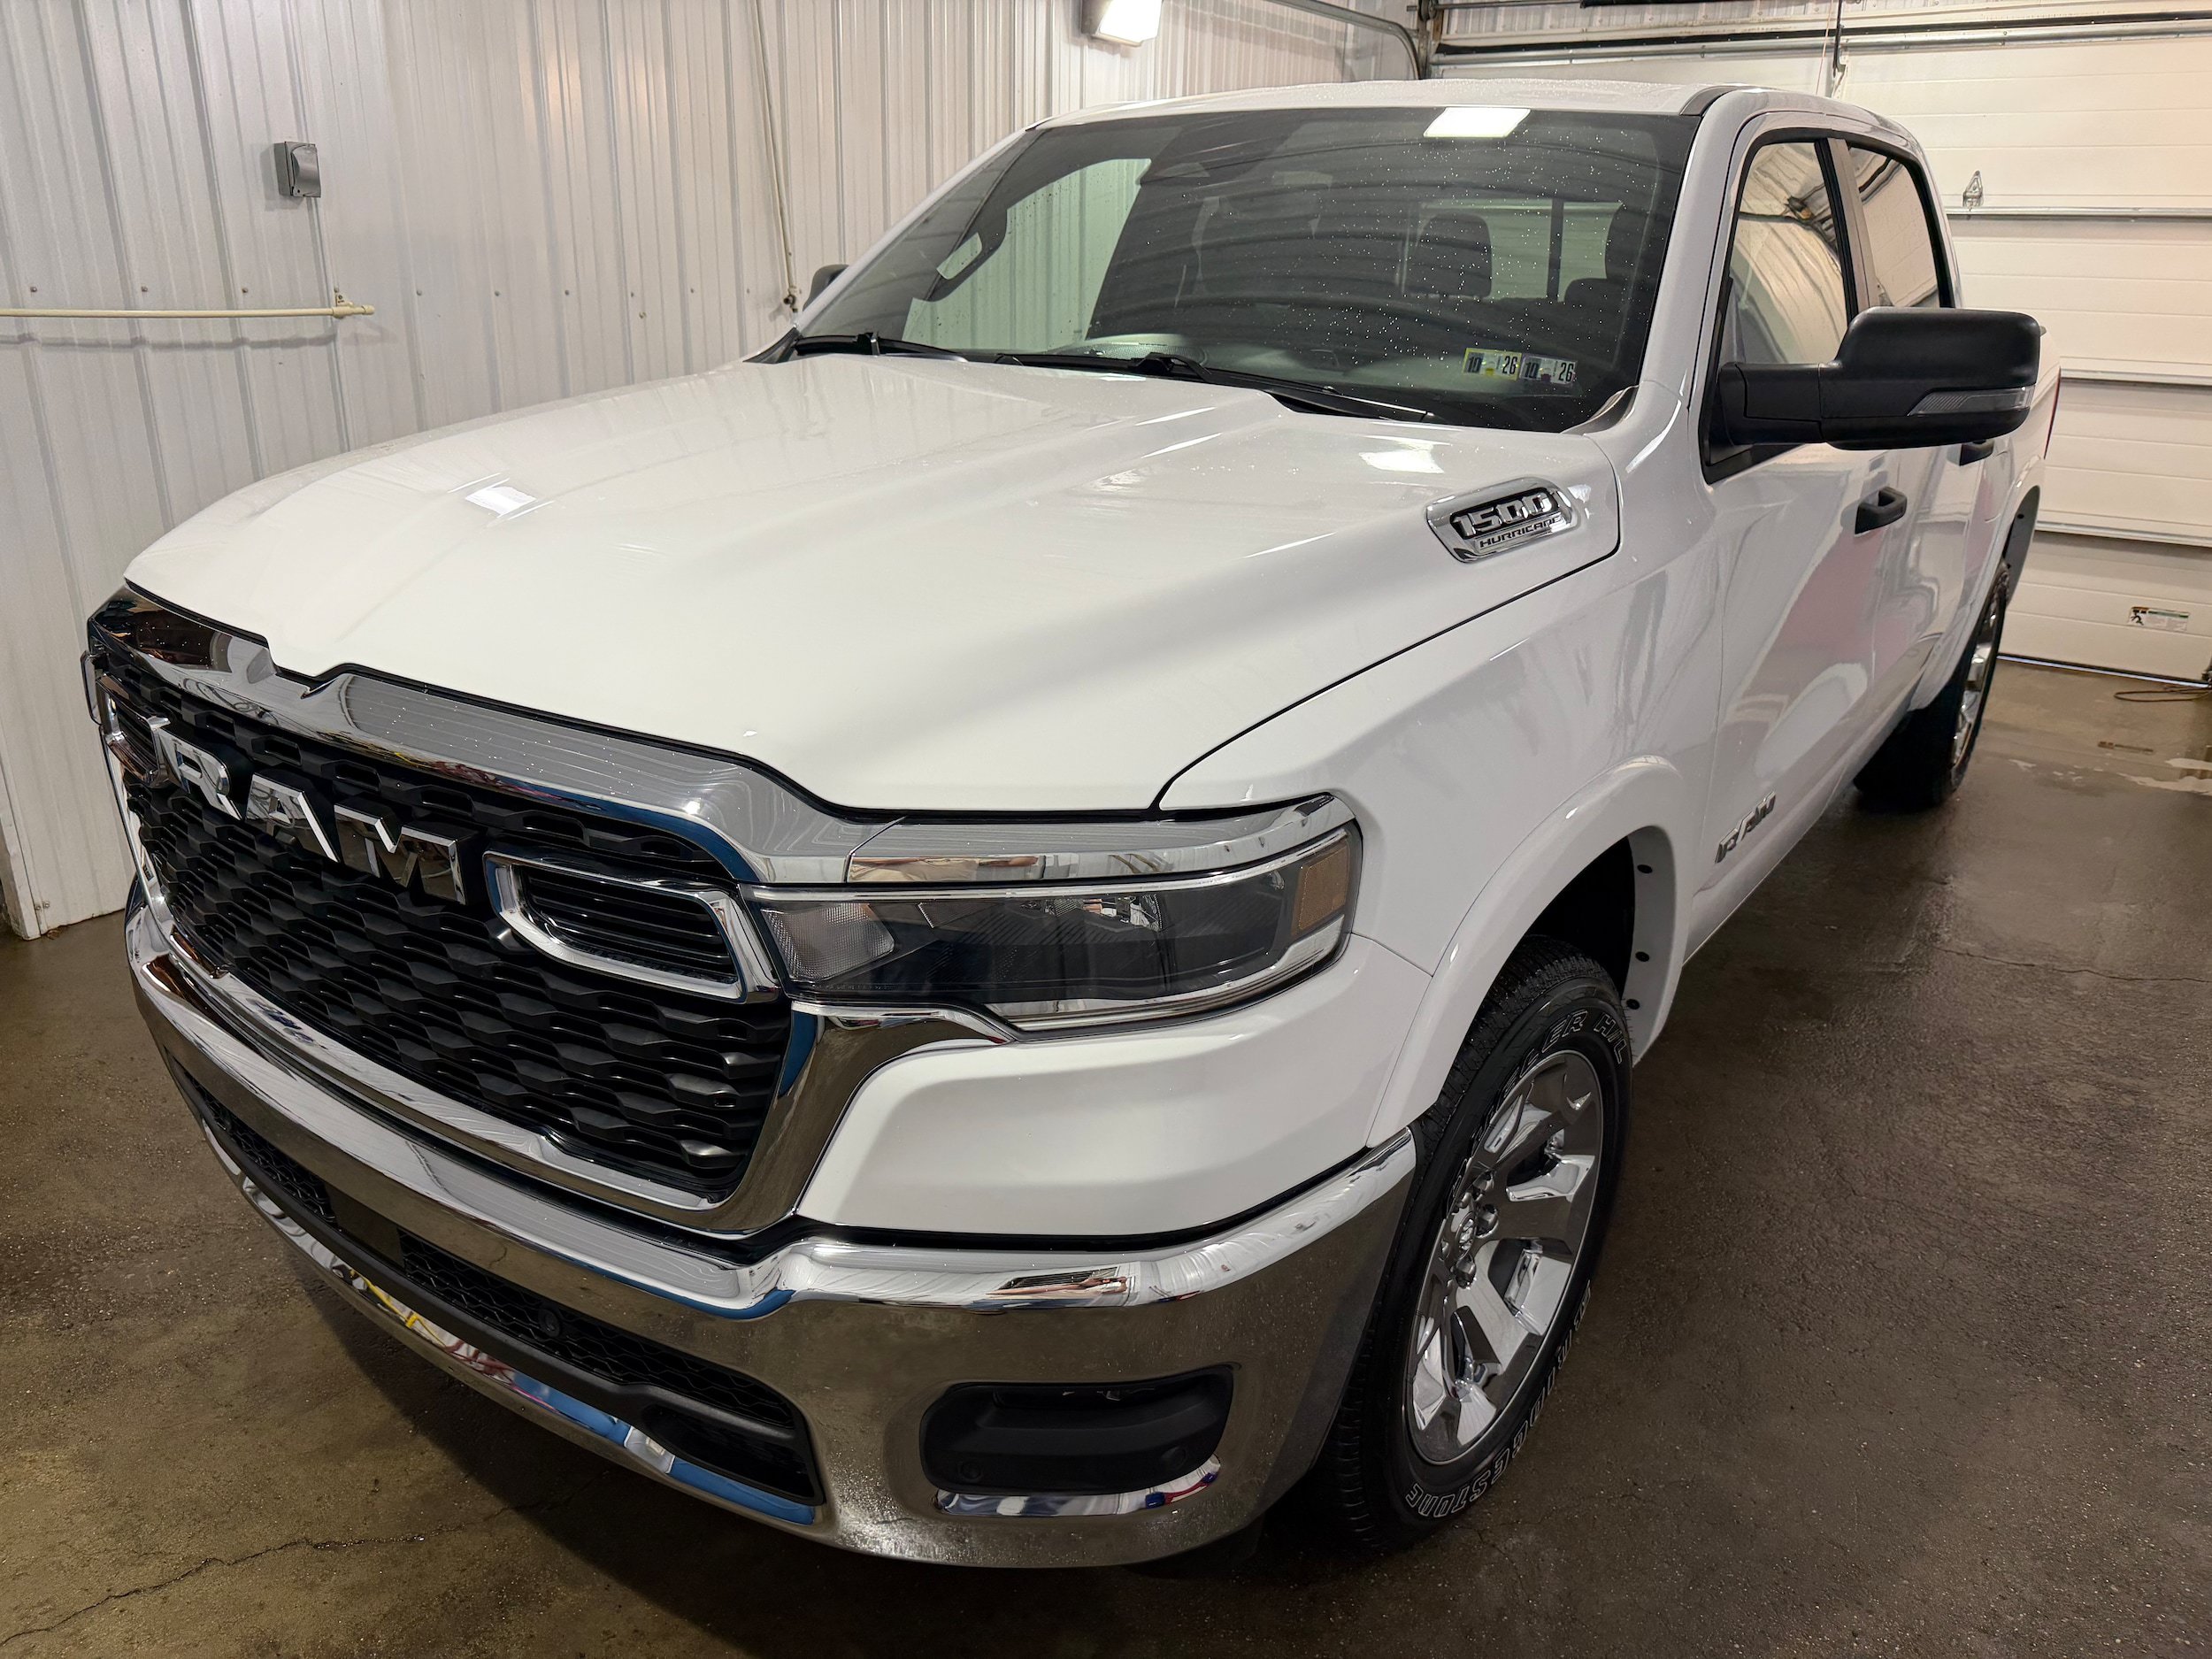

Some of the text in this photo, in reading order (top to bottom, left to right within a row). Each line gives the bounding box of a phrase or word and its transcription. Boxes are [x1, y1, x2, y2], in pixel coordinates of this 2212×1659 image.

[1502, 356, 1517, 374] 26
[1558, 362, 1574, 381] 26
[1452, 492, 1553, 537] 1500
[1480, 516, 1560, 549] HURRICANE
[157, 726, 469, 906] RAM
[1715, 791, 1776, 864] RAM
